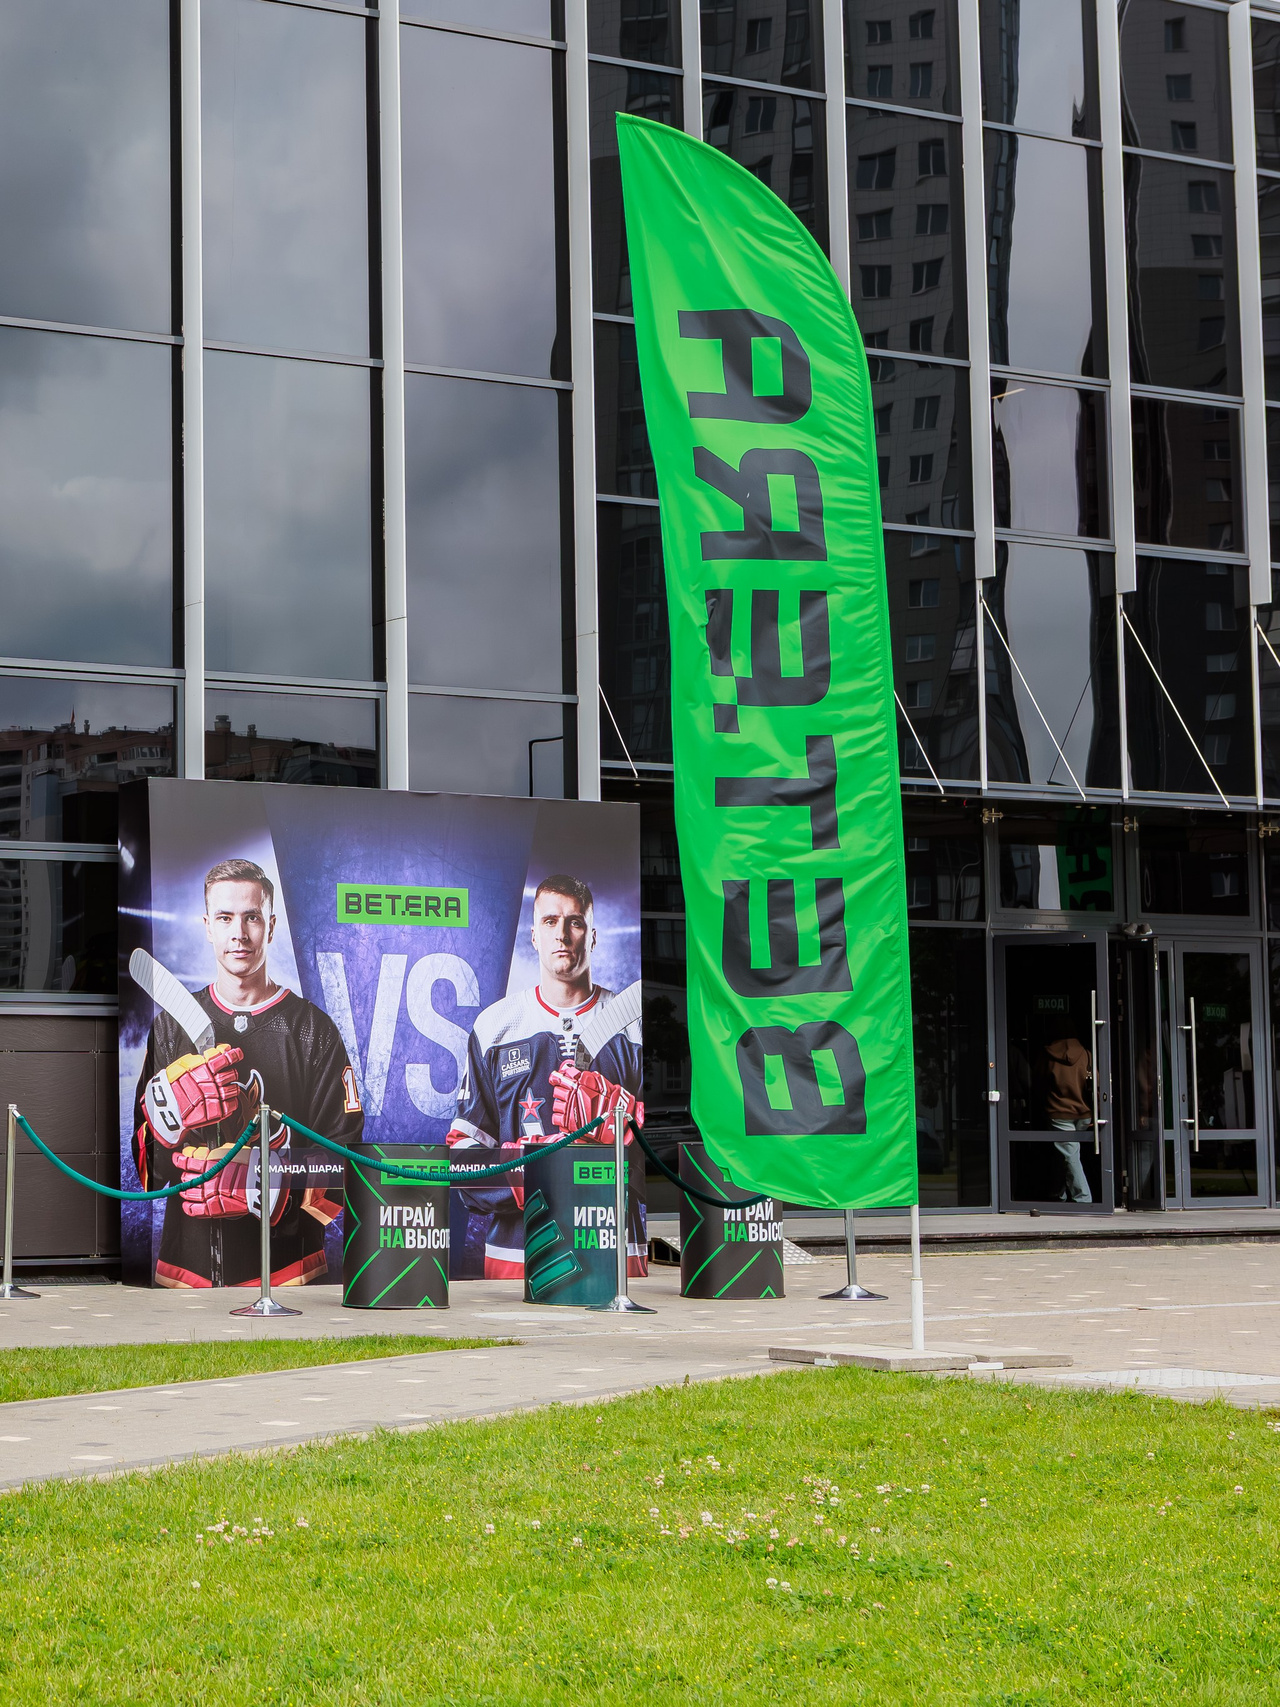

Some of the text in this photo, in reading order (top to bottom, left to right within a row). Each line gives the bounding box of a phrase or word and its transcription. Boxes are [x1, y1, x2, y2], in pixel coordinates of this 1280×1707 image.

[1037, 998, 1065, 1011] ВХОД
[1206, 1005, 1227, 1018] ВХОД
[316, 952, 480, 1119] VS
[501, 1058, 530, 1072] CAESARS
[254, 1164, 306, 1174] КМАНДА
[450, 1164, 486, 1173] МАНДА
[379, 1202, 435, 1227] ИГРАЙ
[574, 1206, 616, 1227] ИГРА
